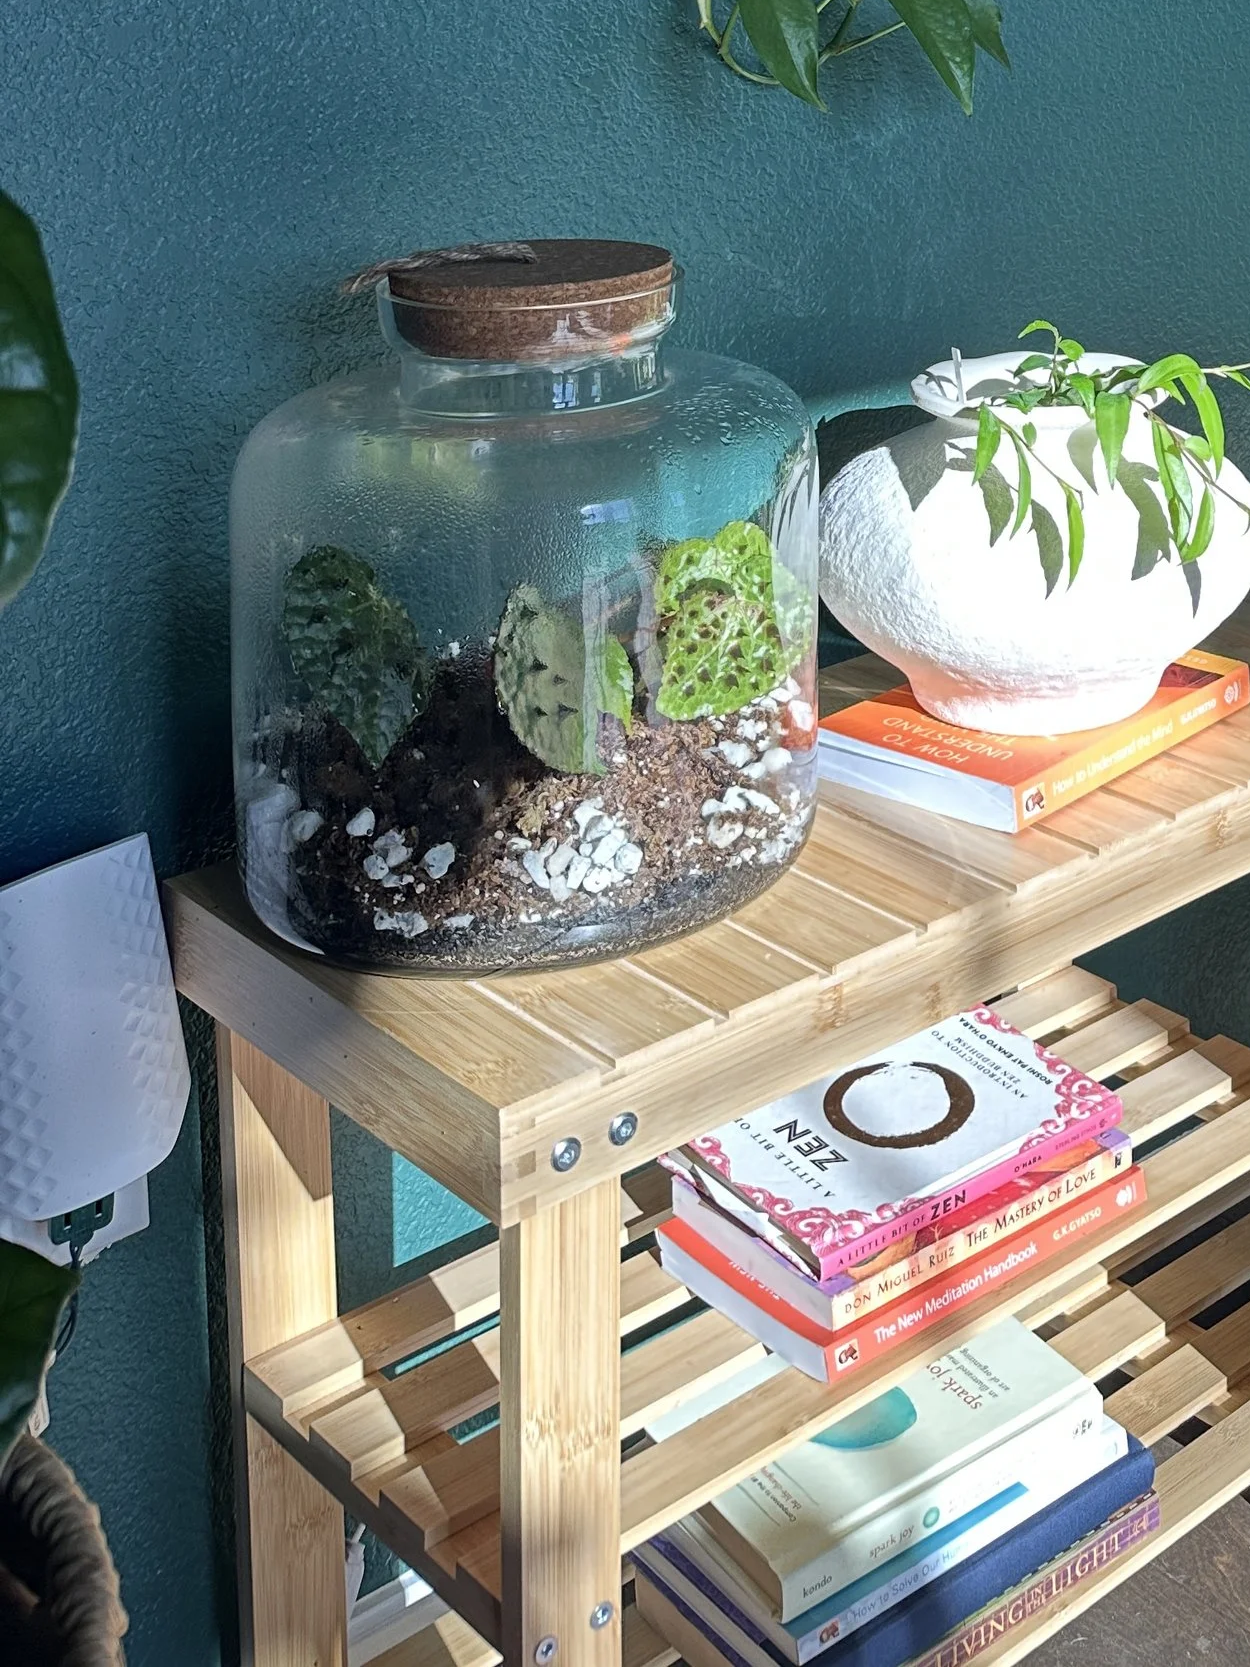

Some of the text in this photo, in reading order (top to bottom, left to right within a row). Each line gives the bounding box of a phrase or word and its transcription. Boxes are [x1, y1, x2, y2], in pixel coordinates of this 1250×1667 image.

[882, 717, 1014, 761] UNDERSTAND
[882, 733, 970, 764] HOW TO
[931, 1030, 1029, 1099] AN INTRODUCTION TO
[955, 1037, 1021, 1085] ZEN BUDDHISM
[959, 1017, 1053, 1086] ROSHI PAT ENKYO O'HARA
[750, 1133, 775, 1151] BIT
[772, 1118, 849, 1172] ZEN
[774, 1151, 822, 1190] LITTLE
[823, 1190, 836, 1198] A
[837, 1258, 844, 1267] A
[848, 1234, 888, 1261] LITTLE
[891, 1223, 909, 1239] BIT
[912, 1214, 926, 1227] OF
[930, 1190, 967, 1221] ZEN
[1014, 1155, 1042, 1173] O'HARA
[844, 1291, 872, 1314] DON
[1047, 1186, 1063, 1203] OF
[874, 1206, 1102, 1343] The New Meditation Handbook G.K.GYATSO
[956, 1364, 989, 1394] illustrated
[960, 1347, 1010, 1392] art of organizing
[941, 1377, 983, 1411] spark
[988, 1390, 999, 1398] an
[770, 1495, 797, 1523] Companion
[802, 1524, 915, 1598] kondo spark joy
[1052, 1529, 1125, 1595] LIGHT
[851, 1600, 876, 1623] How
[879, 1590, 890, 1603] to
[891, 1571, 919, 1595] Solve
[921, 1558, 940, 1576] Our
[1028, 1594, 1047, 1612] THE
[1031, 1583, 1046, 1600] IN
